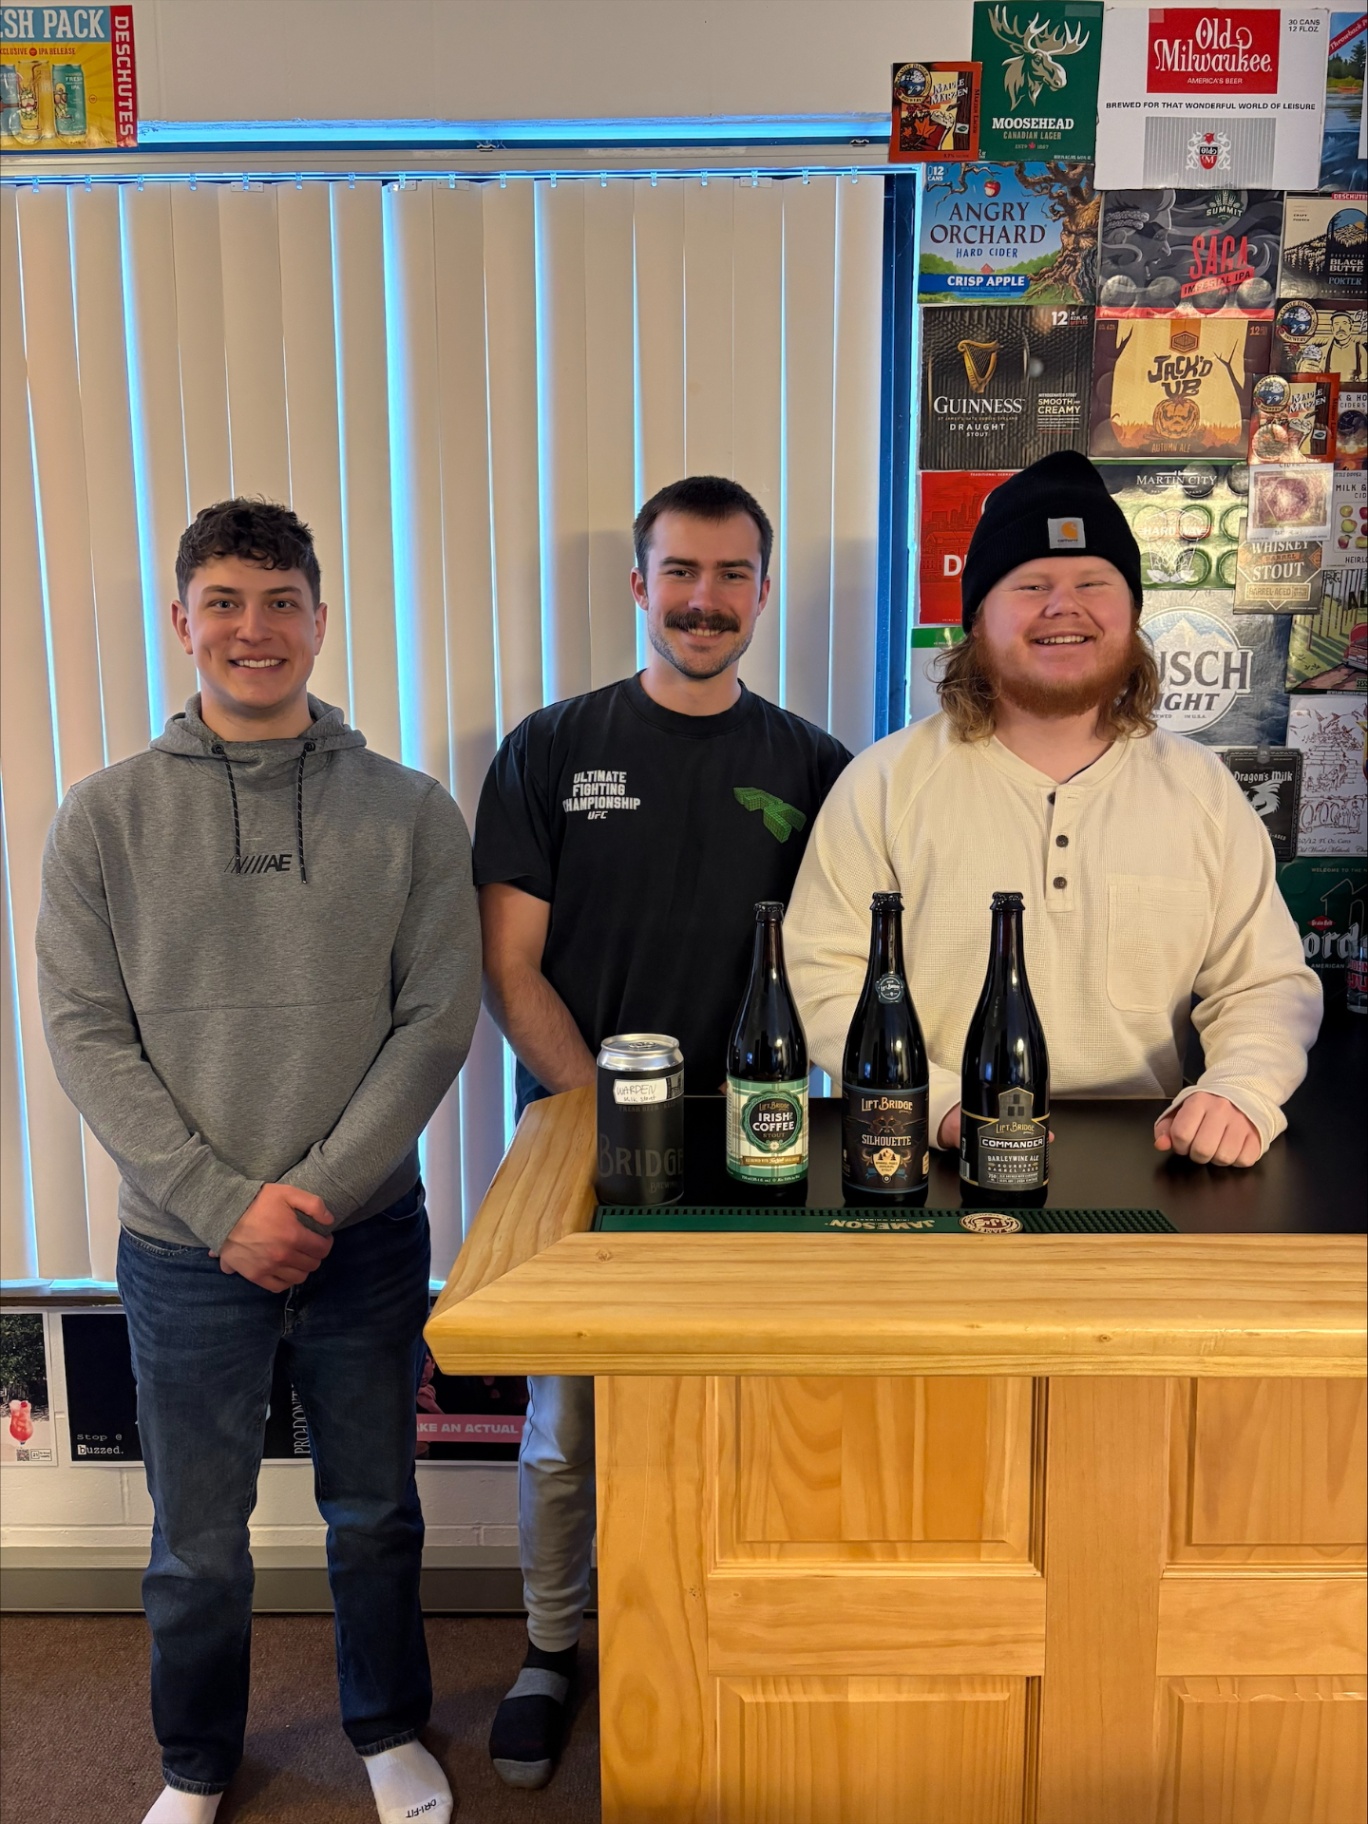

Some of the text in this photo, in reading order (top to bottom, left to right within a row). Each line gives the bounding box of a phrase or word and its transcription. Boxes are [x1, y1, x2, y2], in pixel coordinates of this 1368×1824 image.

[0, 9, 105, 39] SH PACK
[1196, 17, 1246, 50] Old
[1154, 38, 1270, 72] Milwaukee
[114, 15, 135, 137] DESCHUTES
[1187, 77, 1223, 85] AMERICA'S
[1185, 102, 1236, 110] WONDERFUL
[992, 117, 1075, 130] MOOSEHEAD
[1003, 131, 1062, 140] CANADIAN LAGER
[934, 167, 944, 175] 12
[948, 202, 1030, 222] ANGRY
[1206, 206, 1244, 217] SUMMIT
[930, 224, 1046, 244] ORCHARD
[956, 248, 1018, 258] HARD CIDER
[947, 276, 1025, 286] CRISP APPLE
[1234, 271, 1251, 281] IPA
[1328, 277, 1362, 285] PORTER
[1052, 311, 1068, 326] 12
[1250, 326, 1260, 335] 12
[1147, 355, 1213, 383] JACK'D
[934, 396, 1023, 414] GUINNESS
[1038, 406, 1081, 414] CREAMY
[950, 423, 1006, 431] DRAUGHT
[1152, 443, 1191, 453] AUTUMN ALE
[1136, 475, 1217, 485] MARTIN CITY
[1335, 484, 1357, 492] MILK
[1251, 540, 1309, 554] WHISKEY
[1252, 561, 1305, 581] STOUT
[573, 770, 627, 783] ULTIMATE
[1234, 770, 1293, 783] Dragon's Milk
[573, 783, 625, 797] FIGHTING
[587, 810, 608, 820] UFC
[616, 1084, 657, 1096] WARDEN
[861, 1096, 913, 1112] LIFT BRIDGE
[758, 1111, 789, 1122] IRISH
[752, 1120, 794, 1132] COFFEE
[1010, 1121, 1035, 1133] BRIDGE
[861, 1134, 912, 1147] SILHOUETTE
[981, 1138, 1043, 1149] COMMANDER
[831, 1218, 936, 1230] JAMESON
[441, 1423, 461, 1433] AN
[464, 1423, 518, 1434] ACTUAL
[77, 1433, 107, 1441] Stop
[78, 1445, 124, 1455] buzzed.
[406, 1799, 437, 1818] DRI-FIT
